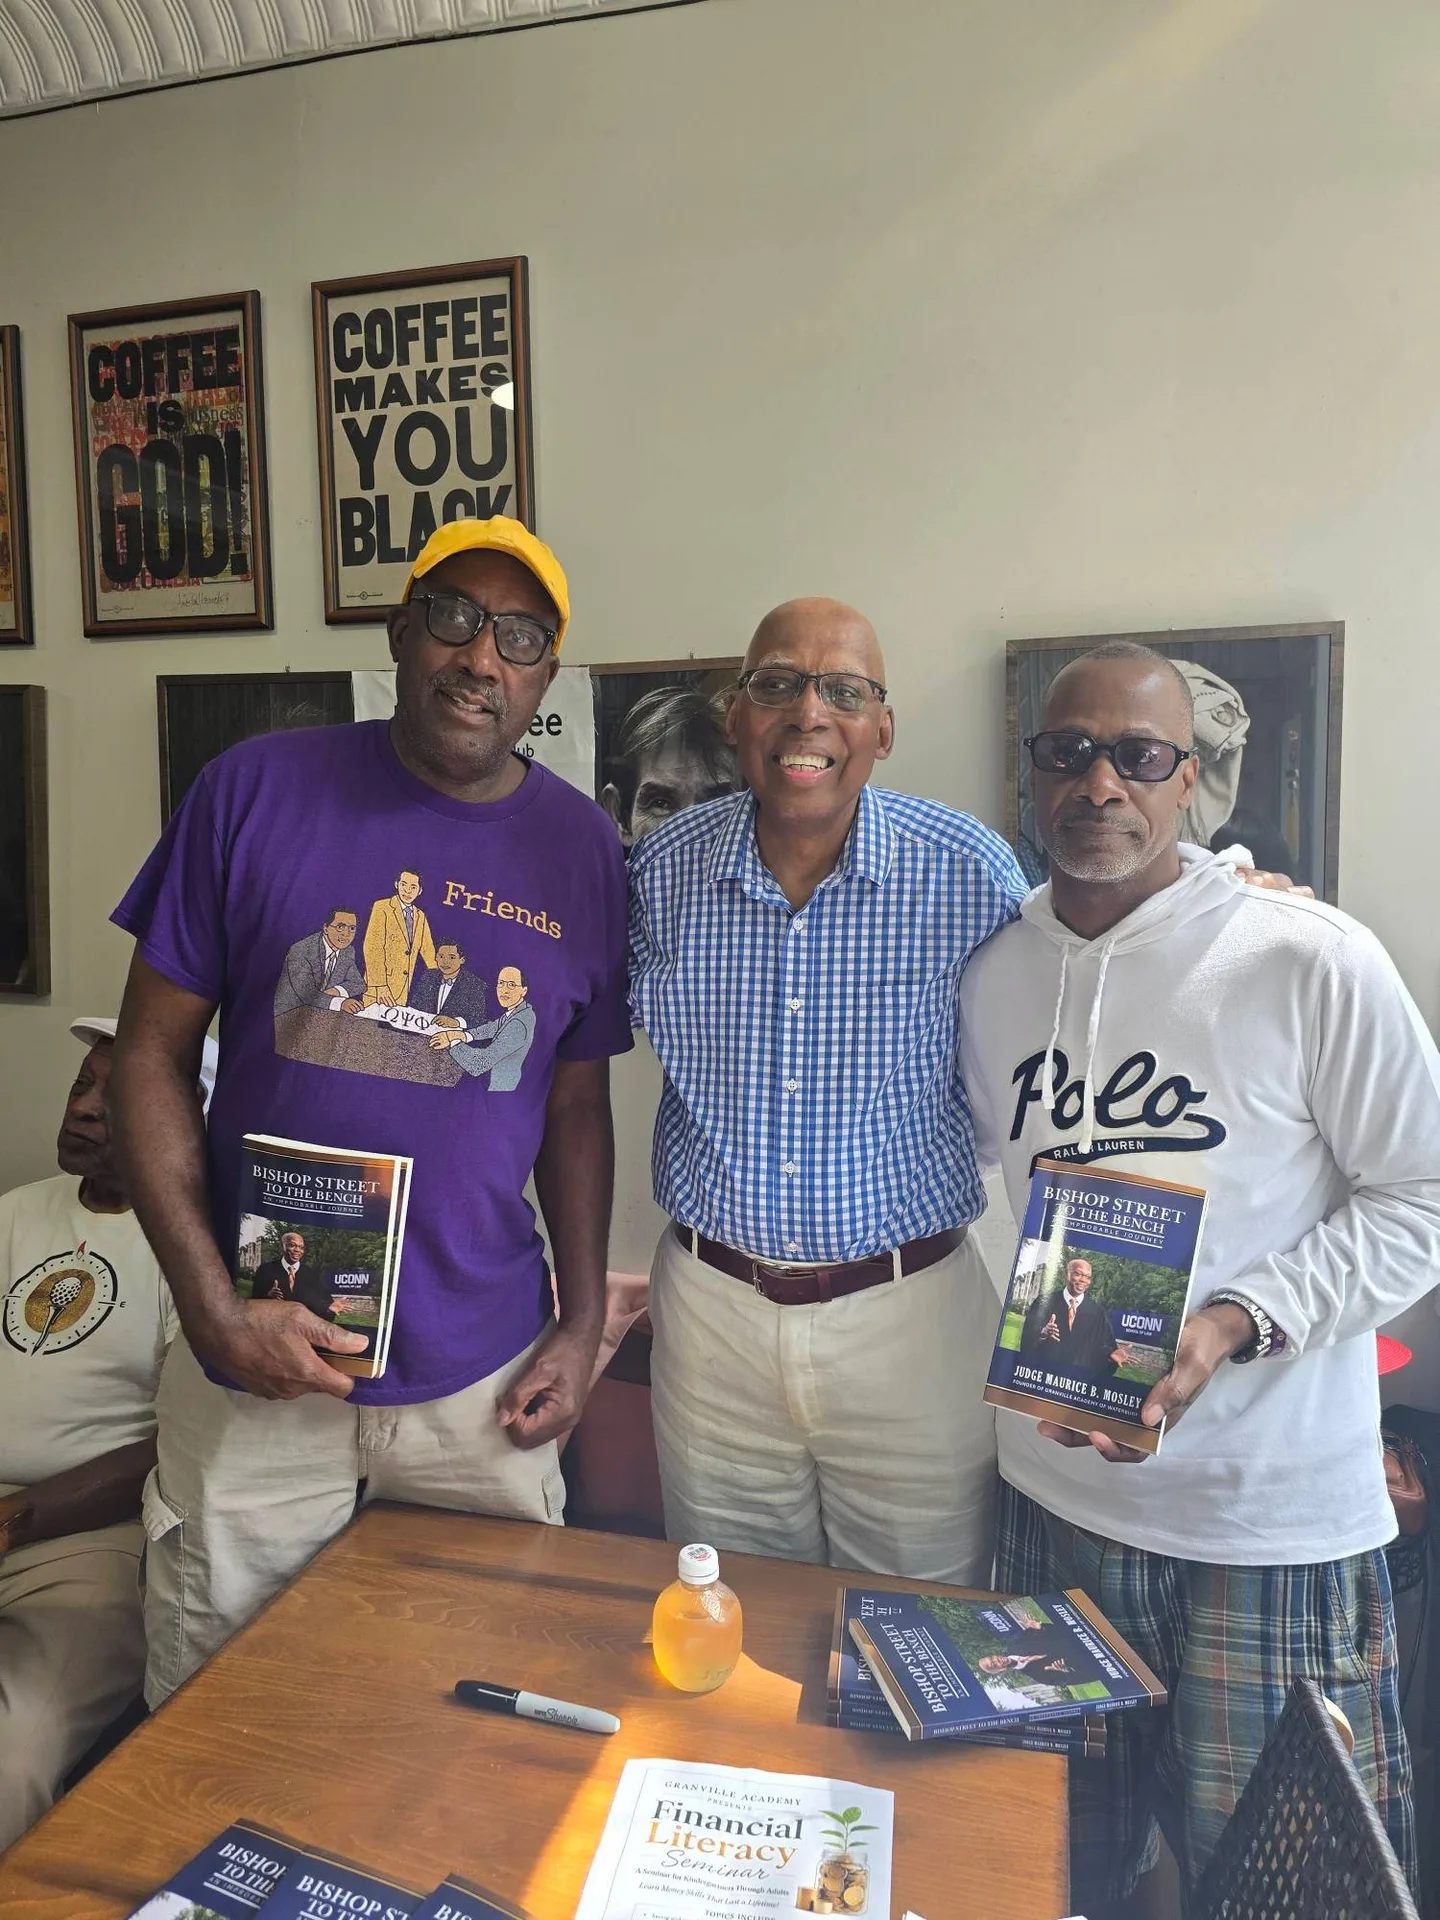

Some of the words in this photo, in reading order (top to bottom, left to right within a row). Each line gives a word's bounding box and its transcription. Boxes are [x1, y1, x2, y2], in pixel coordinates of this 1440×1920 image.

[333, 294, 509, 373] COFFEE
[88, 327, 243, 403] COFFEE
[334, 362, 511, 413] MAKES
[146, 399, 185, 435] IS
[341, 404, 508, 491] YOU
[97, 429, 249, 584] GOD!
[443, 880, 562, 939] Friends
[1009, 1048, 1208, 1141] Polo
[1053, 1144, 1093, 1159] RAL
[1097, 1140, 1145, 1152] LAUREN
[253, 1164, 312, 1187] BISHOP
[315, 1176, 380, 1194] STREET
[264, 1181, 282, 1194] TO
[285, 1186, 312, 1199] THE
[316, 1190, 363, 1205] BENCH
[275, 1198, 323, 1210] IMPROBABLE
[1043, 1186, 1110, 1209] BISHOP
[1113, 1197, 1186, 1224] STREET
[1079, 1206, 1109, 1223] THE
[1112, 1213, 1165, 1234] BENCH
[1123, 1229, 1164, 1245] JOURNEY
[334, 1273, 370, 1285] UCONN
[1121, 1314, 1163, 1332] UCONN
[1012, 1379, 1036, 1390] FOUNDER
[1044, 1387, 1073, 1400] GRANVILLE
[1073, 1396, 1099, 1407] ACADEMY
[1014, 1365, 1043, 1382] JUDGE
[1045, 1373, 1088, 1395] MAURICE
[1090, 1385, 1099, 1399] B.
[1103, 1388, 1143, 1410] MOSLEY
[880, 1622, 917, 1664] STREET
[901, 1629, 930, 1661] BENCH
[922, 1661, 943, 1684] THE
[908, 1665, 948, 1713] BISHOP
[936, 1683, 954, 1700] TO
[665, 1781, 737, 1798] GRANVILLE
[741, 1793, 802, 1806] ACADEMY
[707, 1797, 752, 1811] PRESENTS
[652, 1798, 804, 1840] Financial
[645, 1820, 798, 1869] Literacy
[221, 1861, 246, 1879] TO
[661, 1849, 770, 1880] Seminar
[296, 1874, 382, 1917] BISHOP
[638, 1881, 660, 1891] Learn
[661, 1884, 684, 1896] Money
[685, 1888, 705, 1899] Skills
[707, 1892, 723, 1904] That
[725, 1895, 741, 1905] Last
[643, 1867, 671, 1878] Seminar
[672, 1873, 682, 1881] for
[736, 1884, 765, 1895] Through
[766, 1886, 790, 1896] Adults
[307, 1897, 333, 1918] TO
[705, 1910, 735, 1920] TOPICS
